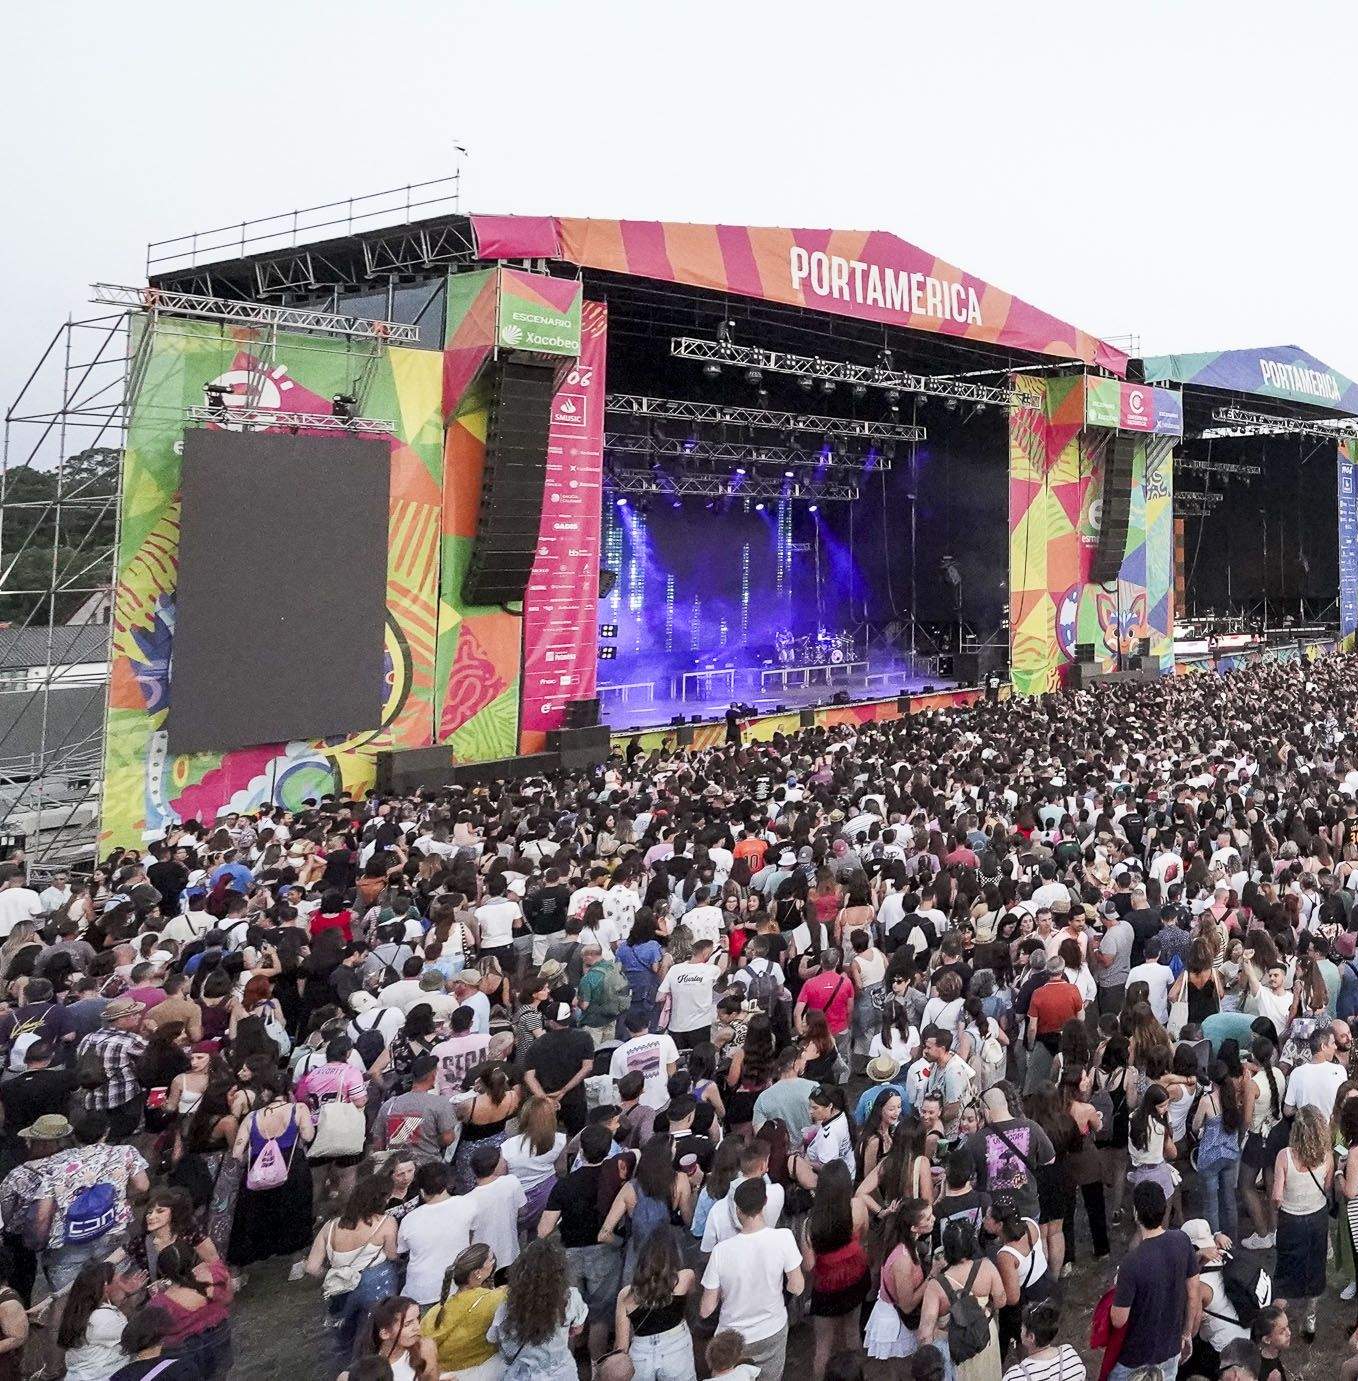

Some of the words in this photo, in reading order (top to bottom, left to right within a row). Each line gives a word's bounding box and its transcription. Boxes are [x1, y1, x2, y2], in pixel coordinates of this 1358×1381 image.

[790, 246, 982, 326] PORTAMÉRICA
[512, 312, 572, 328] ESCENARIO
[527, 332, 579, 349] Xacobeo
[554, 413, 582, 423] SMUSIC
